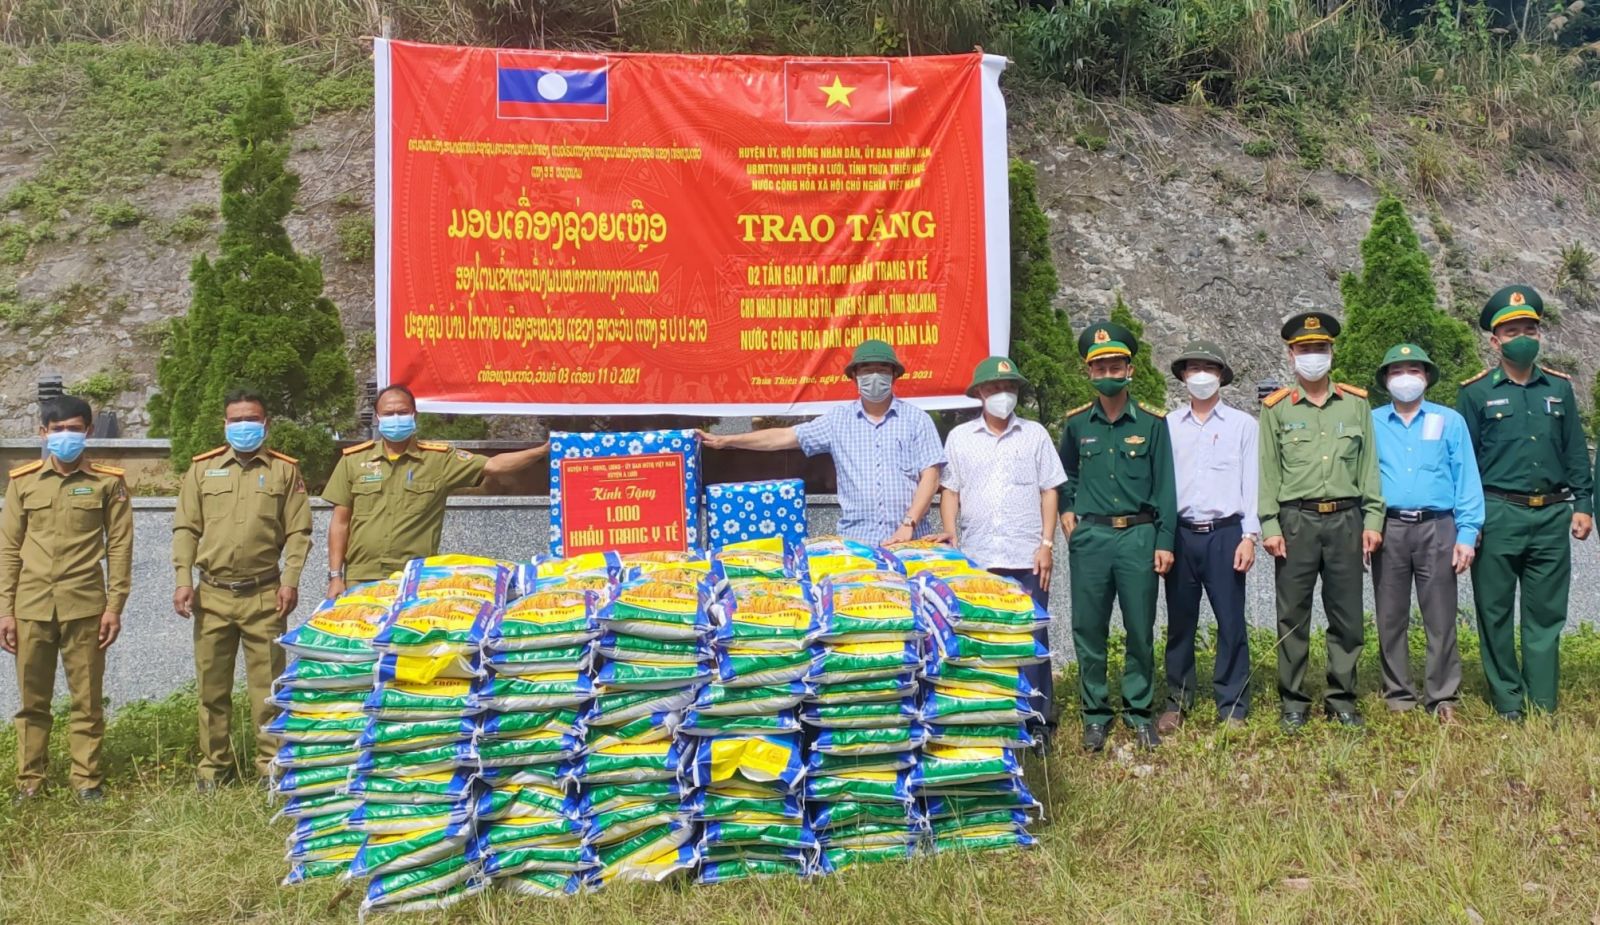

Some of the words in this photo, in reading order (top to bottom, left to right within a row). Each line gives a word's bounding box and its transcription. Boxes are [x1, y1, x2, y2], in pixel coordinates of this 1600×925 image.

[739, 145, 765, 160] HUYỆN
[781, 145, 794, 160] HỘI
[820, 145, 842, 159] NHÂN
[876, 147, 892, 159] BAN
[894, 146, 916, 159] NHÂN
[791, 162, 817, 177] HUYỆN
[819, 164, 825, 175] A
[776, 178, 798, 194] CỘNG
[830, 178, 843, 194] HỘI
[737, 213, 835, 242] TRAO
[846, 209, 937, 247] TẶNG
[747, 265, 760, 286] 02
[762, 258, 782, 286] TẤN
[783, 265, 803, 291] GẠO
[806, 260, 819, 286] VÀ
[821, 264, 847, 286] 1.000
[849, 255, 874, 285] KHẨU
[875, 259, 906, 281] TRANG
[908, 259, 915, 280] Y
[916, 253, 928, 280] TẾ
[741, 297, 755, 318] CHO
[756, 293, 776, 318] NHÂN
[777, 293, 792, 318] DÂN
[835, 292, 856, 320] HUYỆN
[907, 292, 937, 314] SALAVAN
[740, 325, 768, 351] NƯỚC
[771, 325, 798, 355] CỘNG
[800, 325, 821, 351] HÒA
[822, 325, 842, 349] DÂN
[844, 320, 864, 348] CHỦ
[866, 321, 894, 346] NHÂN
[896, 320, 917, 346] DÂN
[919, 320, 938, 346] LÀO
[558, 367, 569, 385] 03
[598, 368, 608, 384] 11
[619, 367, 641, 385] 2021
[912, 370, 933, 379] 2021
[590, 486, 622, 501] Kính
[625, 485, 657, 501] Tặng
[606, 504, 641, 523] 1.000
[569, 524, 604, 547] KHẨU
[608, 527, 649, 545] TRANG
[651, 525, 661, 543] Y
[664, 520, 680, 542] TẾ
